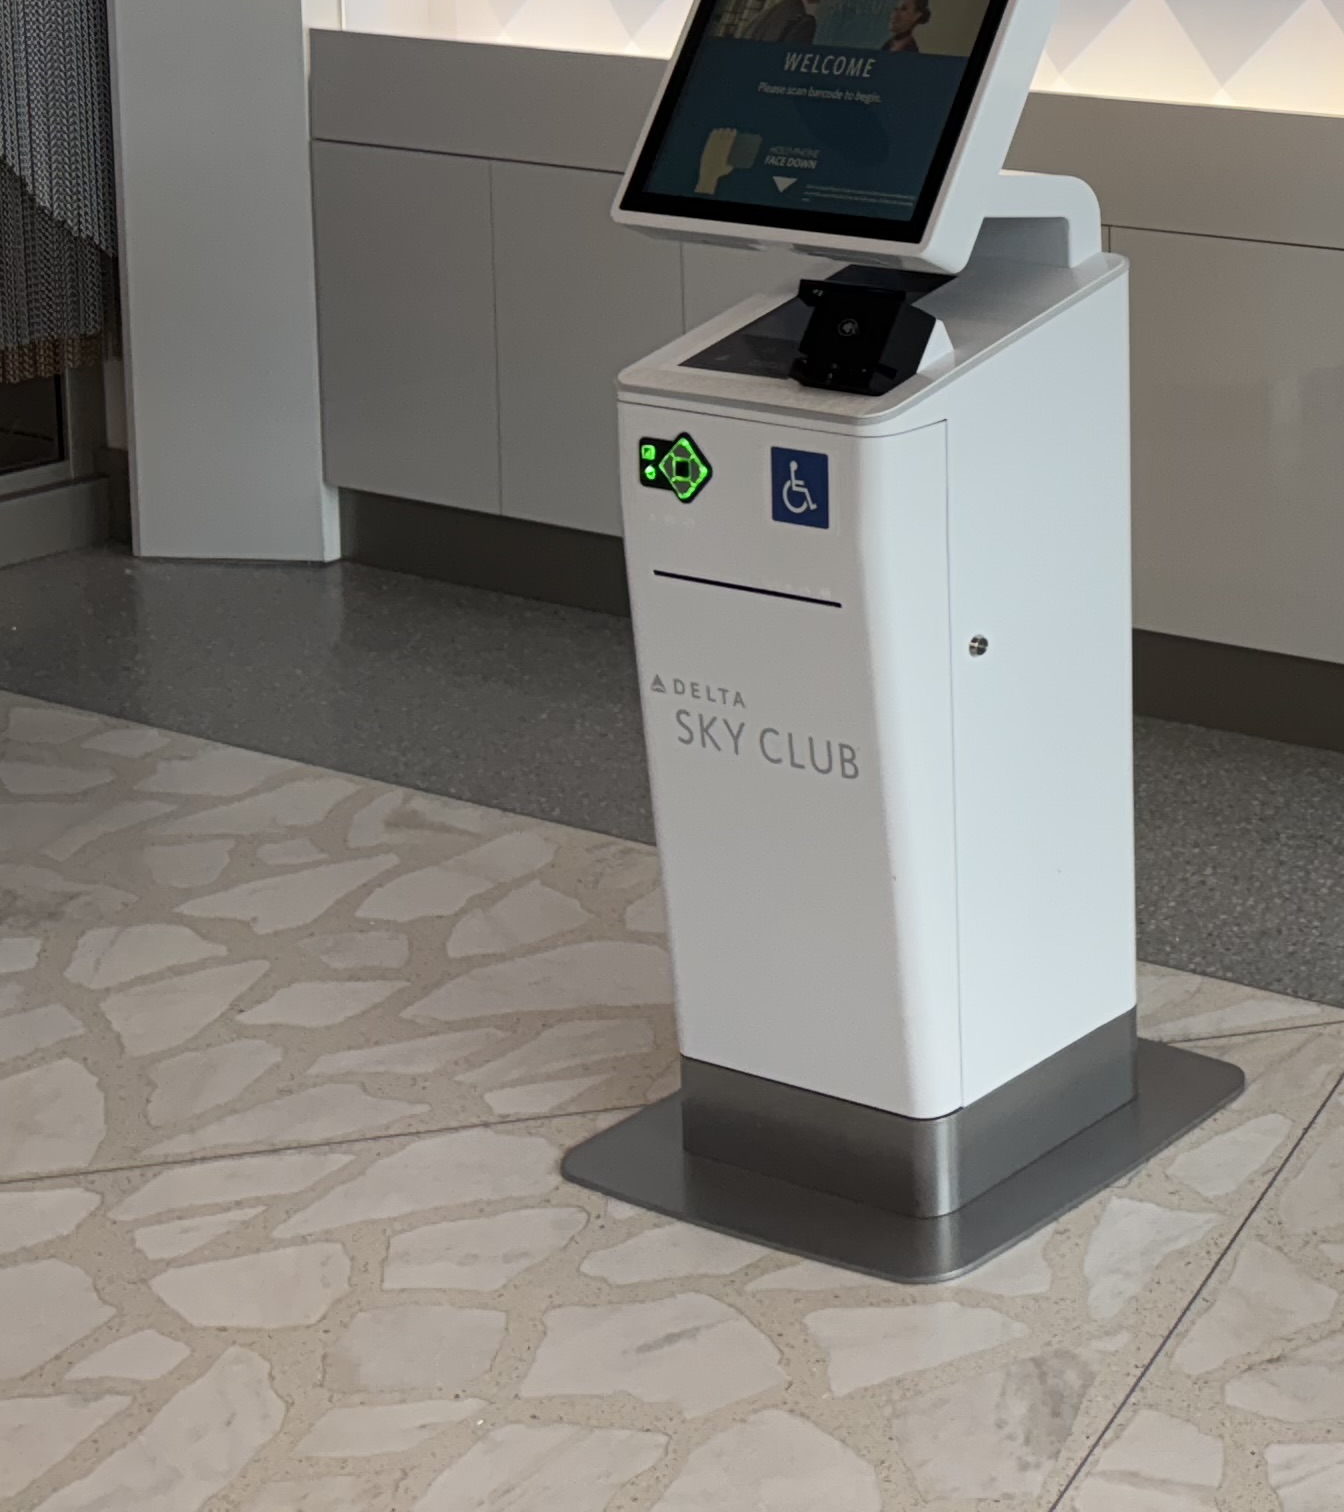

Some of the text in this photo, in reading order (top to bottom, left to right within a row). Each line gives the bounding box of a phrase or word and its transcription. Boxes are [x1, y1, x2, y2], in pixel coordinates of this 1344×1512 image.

[783, 51, 877, 78] WELCOME
[757, 81, 786, 96] Please
[764, 154, 818, 169] FACE DOWN
[673, 678, 747, 709] DELTA
[676, 709, 860, 780] SKY CLUB
